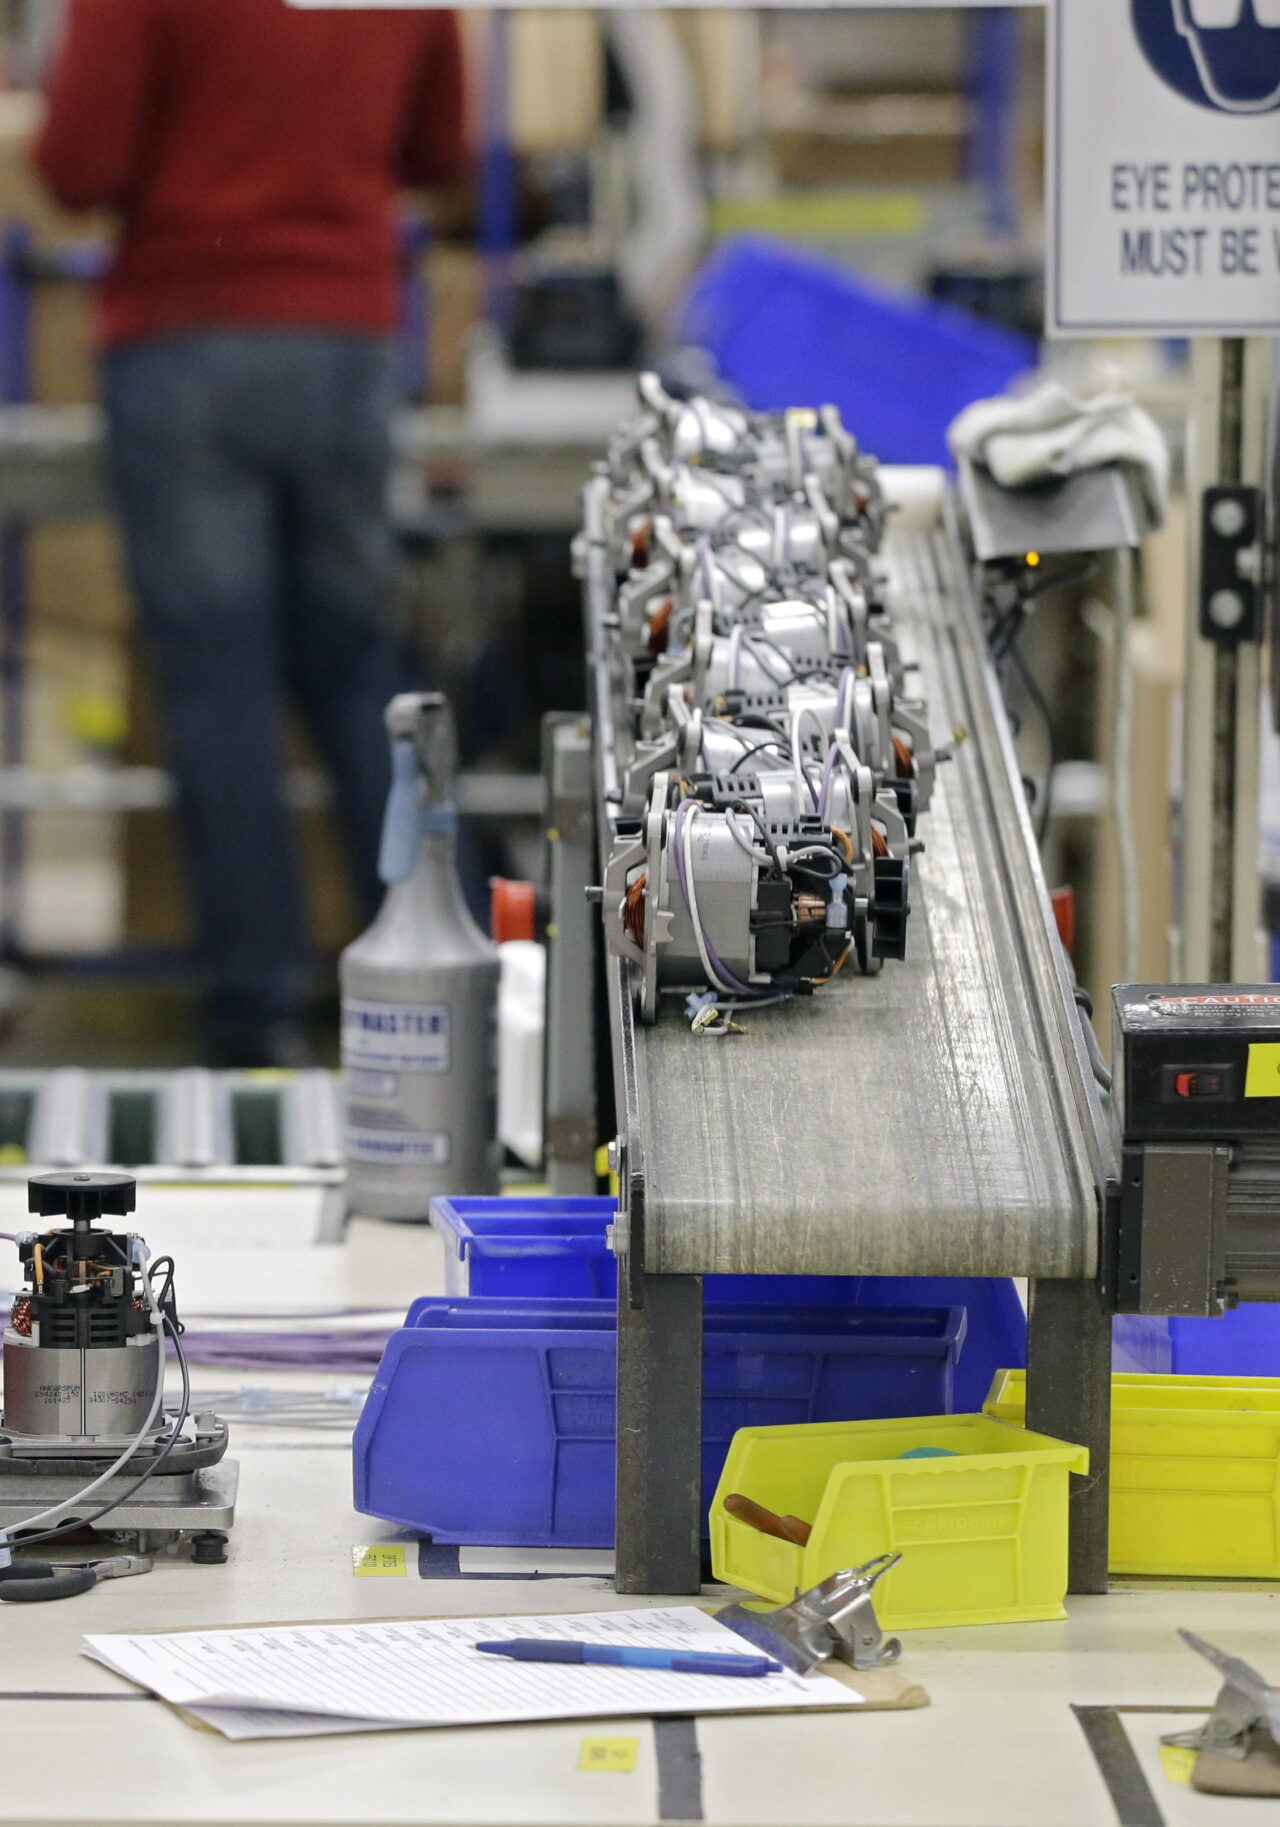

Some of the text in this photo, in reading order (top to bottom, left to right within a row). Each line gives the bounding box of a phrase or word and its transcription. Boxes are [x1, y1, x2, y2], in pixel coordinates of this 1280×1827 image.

[1111, 163, 1171, 212] EYE
[1121, 228, 1207, 276] MUST
[1220, 228, 1260, 276] BE
